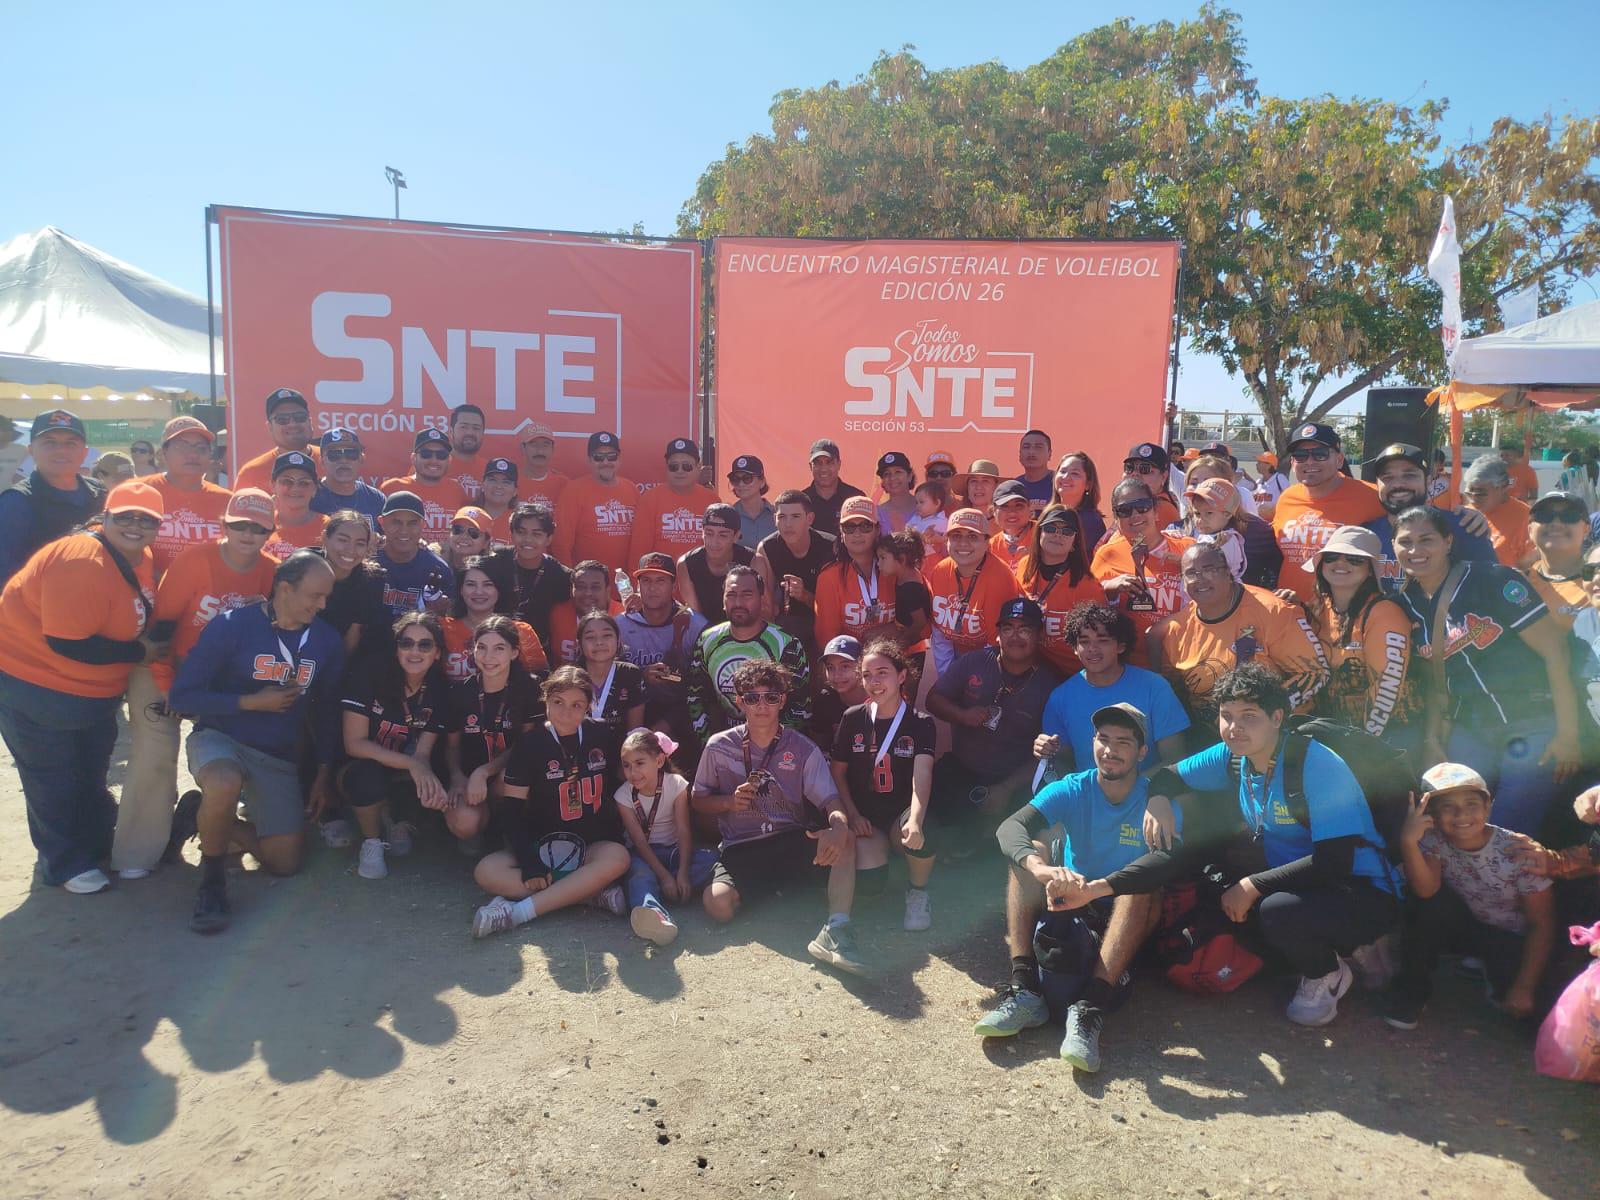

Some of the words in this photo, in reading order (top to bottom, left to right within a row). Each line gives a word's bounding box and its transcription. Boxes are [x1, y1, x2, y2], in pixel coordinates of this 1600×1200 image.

[728, 253, 860, 274] ENCUENTRO
[865, 255, 1011, 276] MAGISTERIAL
[1018, 257, 1047, 275] DE
[1054, 257, 1161, 278] VOLEIBOL
[880, 277, 974, 301] EDICIÓN
[977, 282, 1005, 301] 26
[916, 319, 961, 344] Todos
[311, 291, 596, 414] SNTE
[884, 329, 980, 374] Somos
[844, 346, 1017, 417] SNTE
[317, 409, 415, 433] SECCIÓN
[423, 415, 448, 433] 53
[844, 419, 906, 432] SECCIÓN
[908, 421, 925, 432] 53
[424, 512, 453, 529] NTE
[253, 654, 313, 686] SNE
[1365, 630, 1407, 736] SCUINAPA
[558, 773, 604, 821] 04
